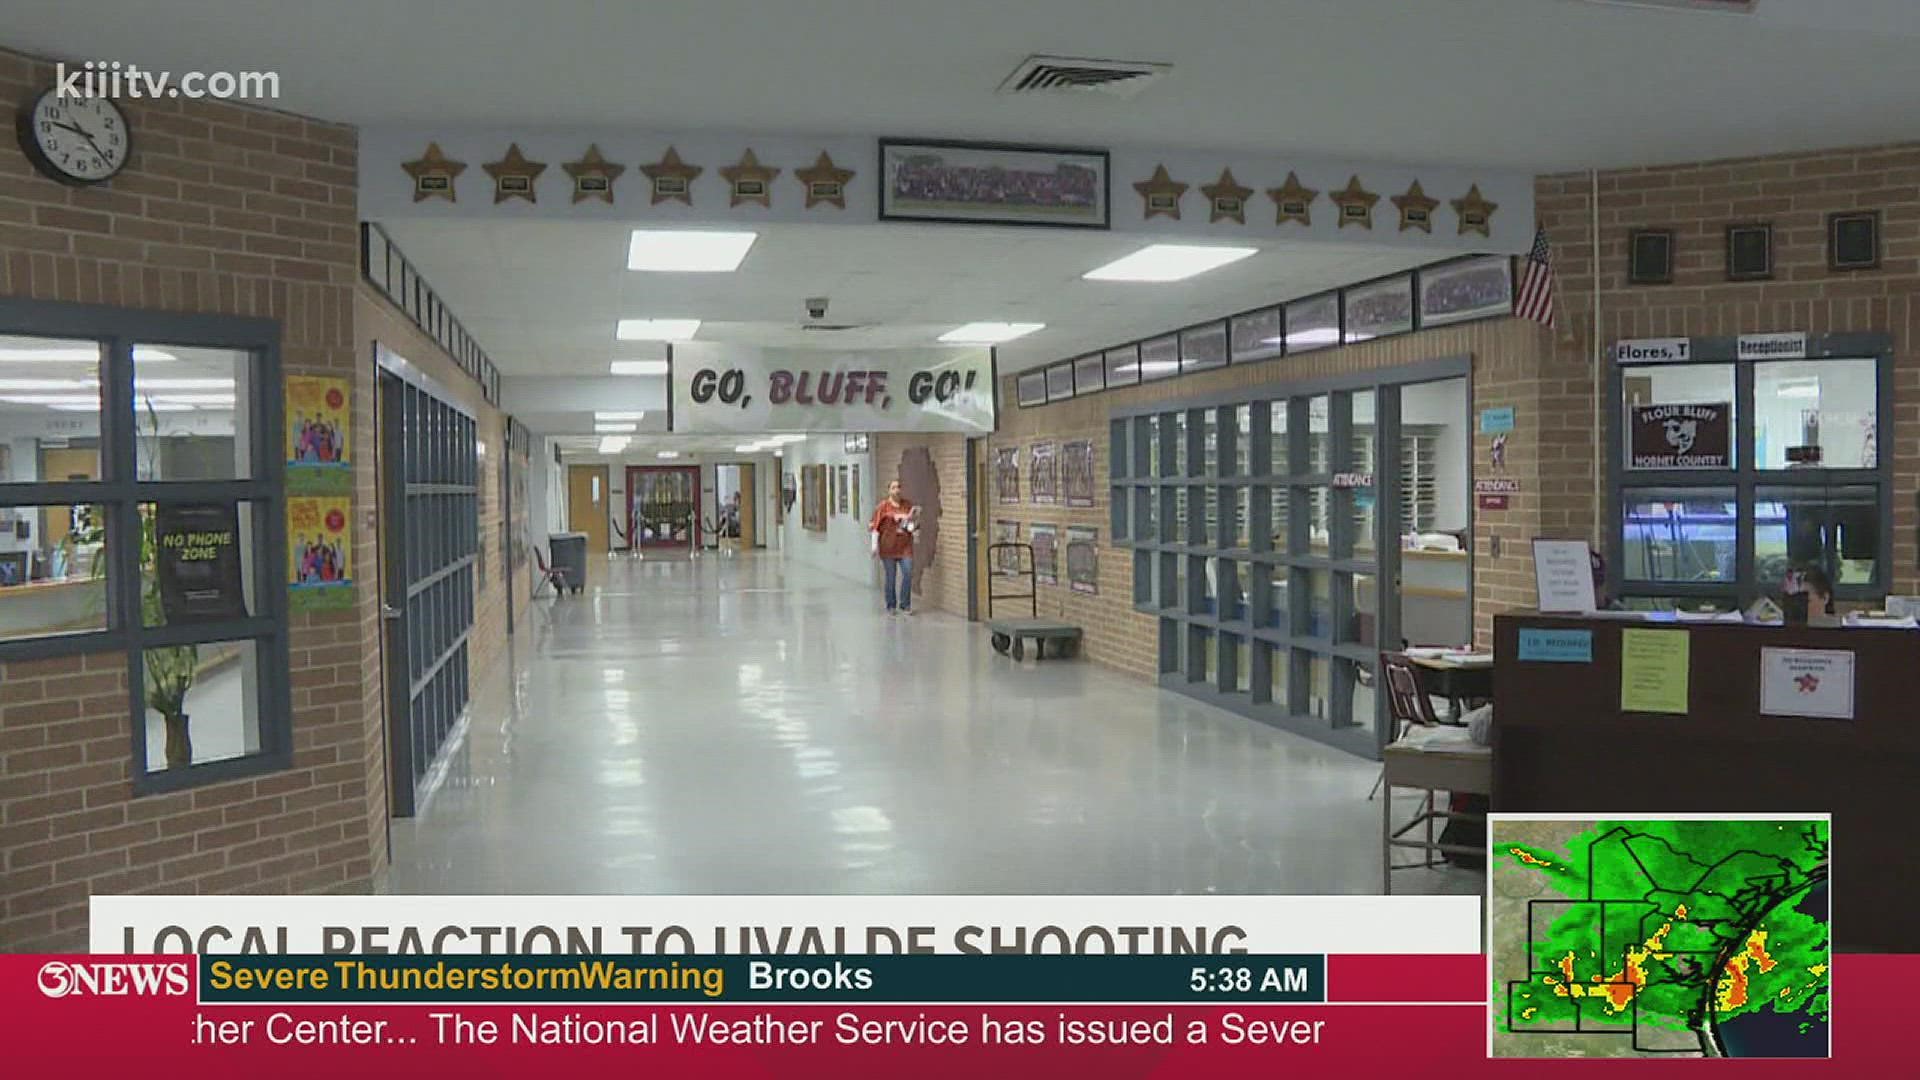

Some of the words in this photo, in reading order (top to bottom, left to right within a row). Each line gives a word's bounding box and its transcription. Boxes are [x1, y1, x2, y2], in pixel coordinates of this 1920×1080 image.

[45, 106, 60, 119] 10
[104, 117, 114, 130] 2
[1618, 346, 1673, 360] Flores,
[1678, 343, 1687, 357] T
[1740, 339, 1803, 355] Receptionist
[690, 368, 752, 410] GO,
[768, 369, 892, 411] BLUFF,
[908, 369, 977, 405] GO!
[1641, 405, 1681, 424] FLOUR
[1683, 404, 1718, 421] BLUFF
[1635, 455, 1673, 467] HORNET
[1677, 454, 1724, 466] COUNTRY
[163, 534, 185, 548] NO
[187, 532, 232, 547] PHONE
[181, 547, 217, 560] ZONE
